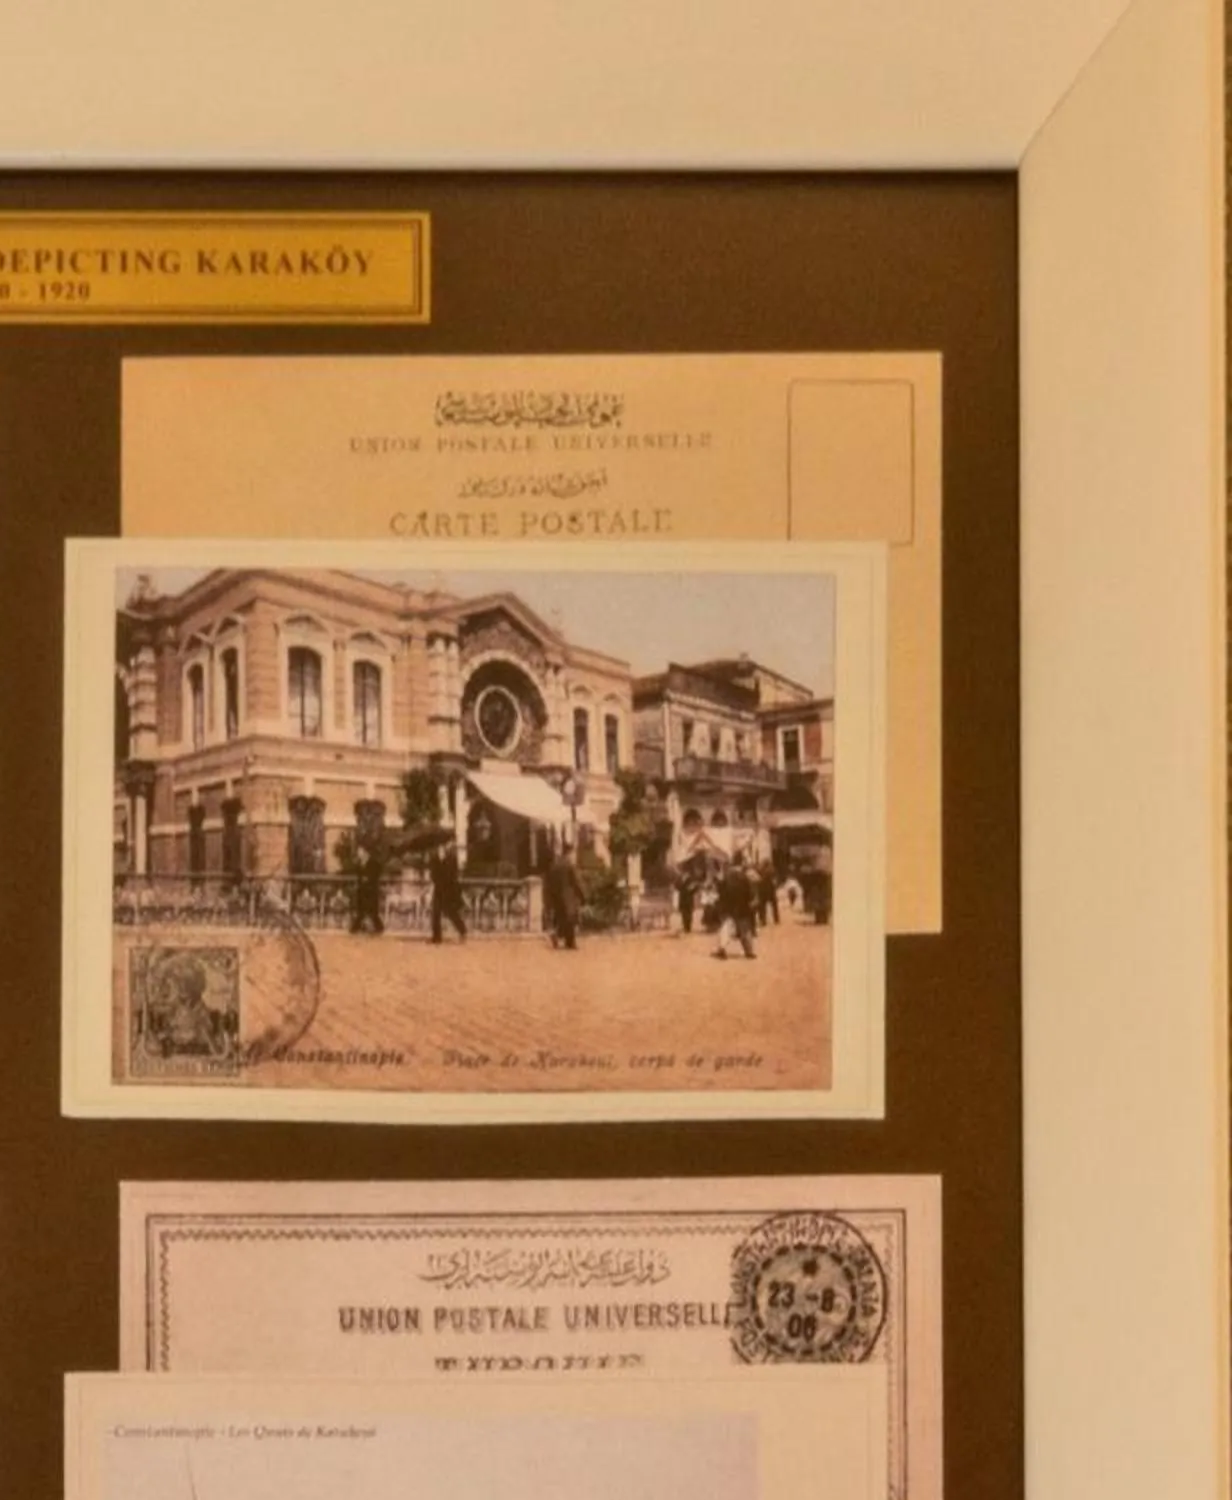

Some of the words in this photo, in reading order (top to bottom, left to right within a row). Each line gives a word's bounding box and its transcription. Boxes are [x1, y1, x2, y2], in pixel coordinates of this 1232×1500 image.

[196, 244, 372, 275] KARAKÖY
[38, 281, 90, 301] 1920
[349, 436, 422, 453] UNION
[437, 435, 534, 453] POSTALE
[553, 432, 712, 450] UNIVERSELLE
[389, 510, 499, 537] CARTE
[519, 508, 672, 537] POSTALE
[685, 1053, 705, 1068] de
[714, 1051, 763, 1071] garde
[768, 1281, 795, 1308] 23
[338, 1305, 421, 1332] UNION
[434, 1305, 549, 1332] POSTALE
